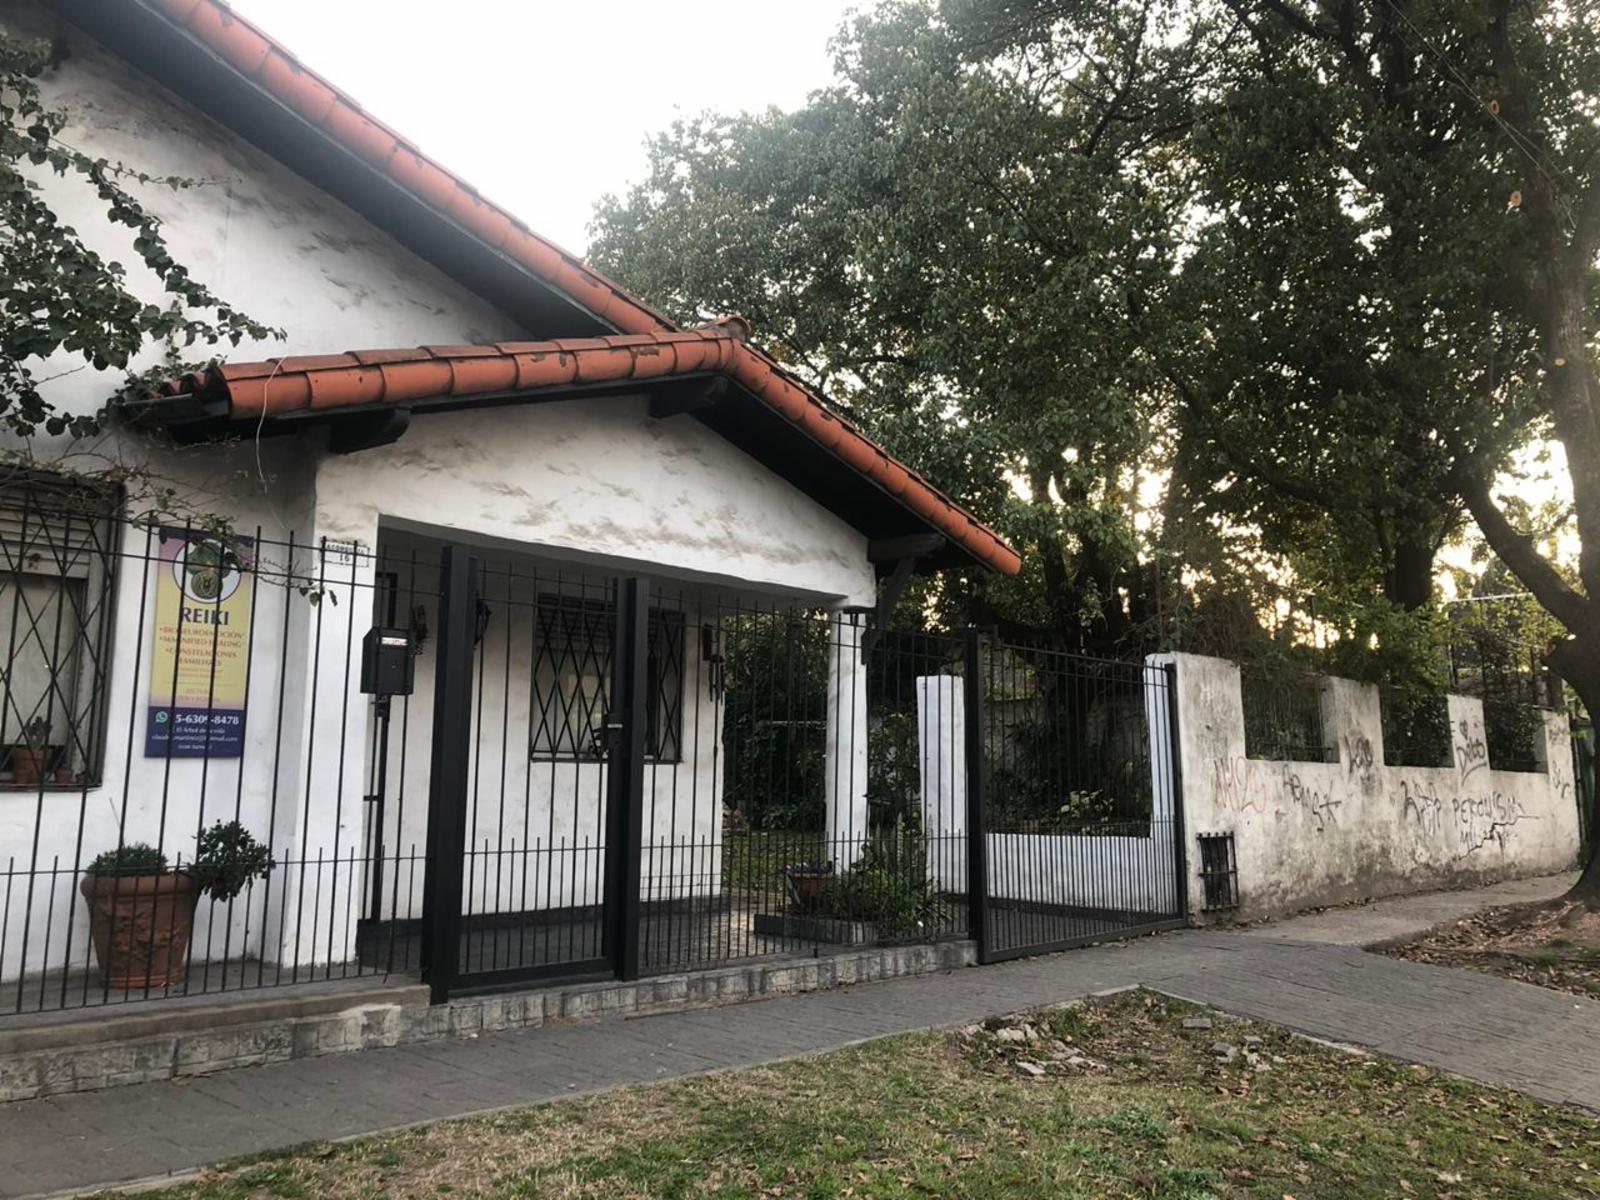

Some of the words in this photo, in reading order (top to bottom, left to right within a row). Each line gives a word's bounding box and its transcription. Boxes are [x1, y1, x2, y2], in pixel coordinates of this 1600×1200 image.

[181, 607, 229, 626] REIKI
[163, 636, 207, 646] MANIFIED
[209, 639, 242, 648] HALING
[174, 713, 239, 725] 5-6309-8478
